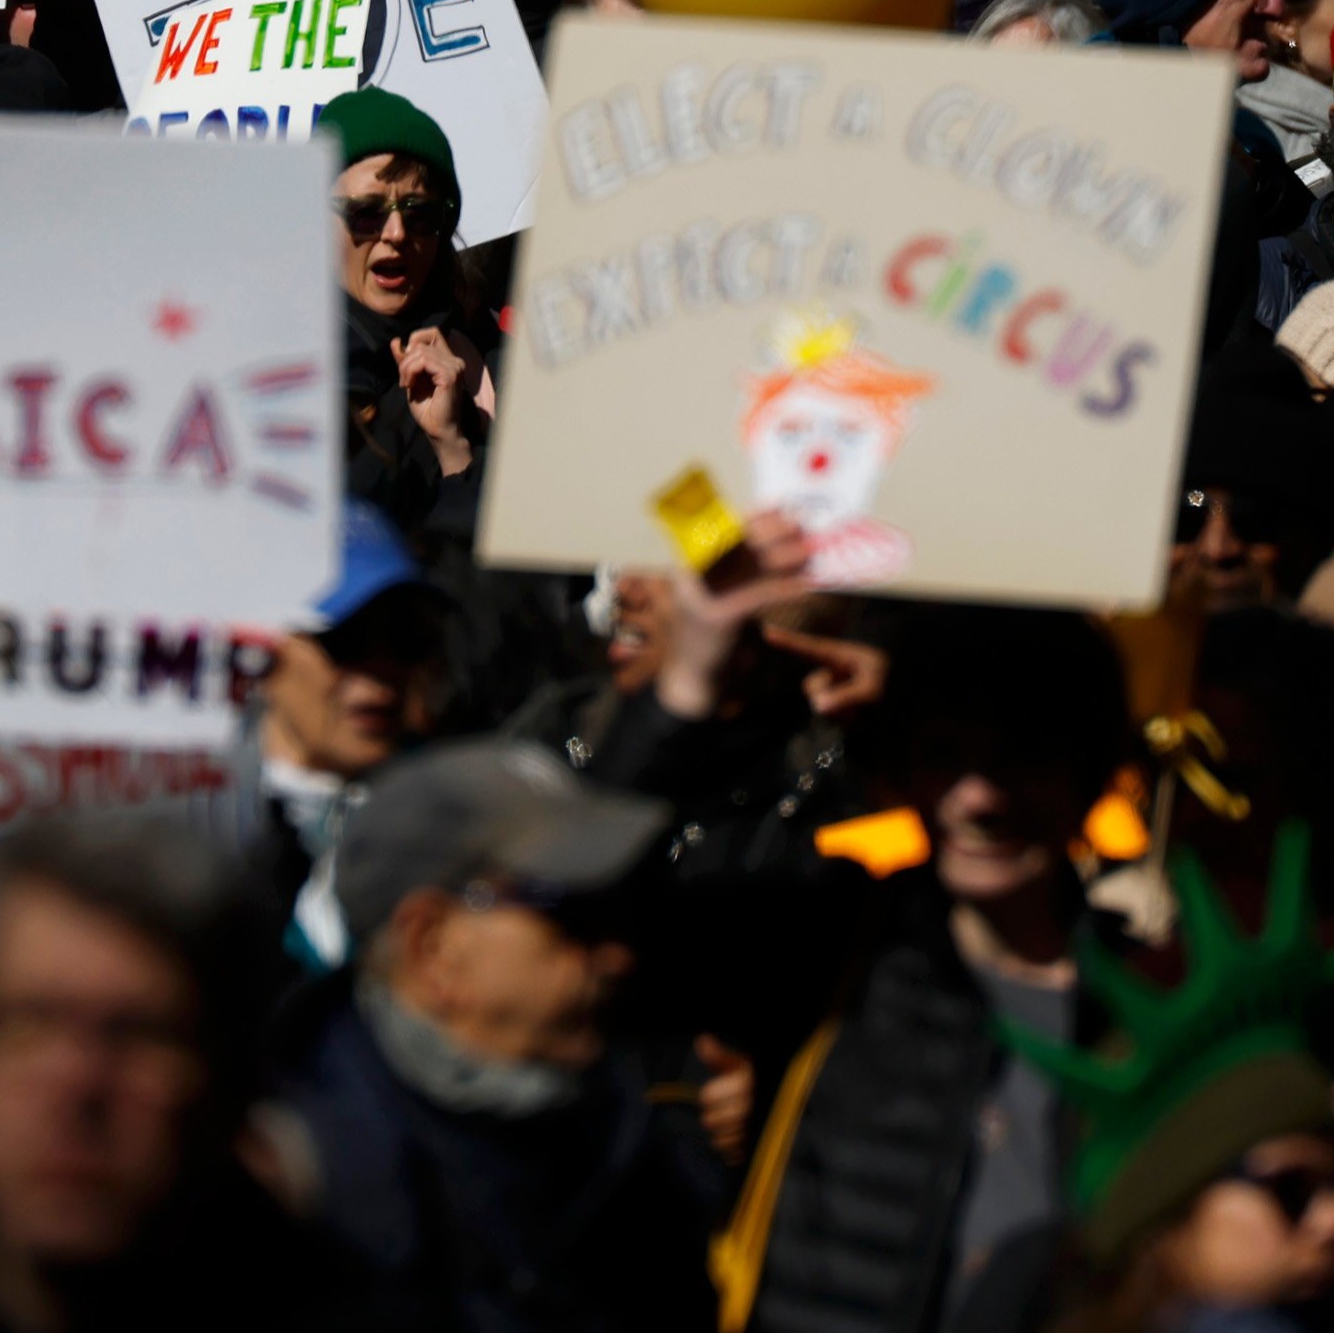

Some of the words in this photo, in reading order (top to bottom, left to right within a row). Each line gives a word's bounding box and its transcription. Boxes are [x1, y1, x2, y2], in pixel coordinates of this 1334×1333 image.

[153, 6, 234, 86] WE
[558, 54, 826, 203] ELECT
[904, 82, 1188, 265] CLOWN
[527, 210, 824, 372] EXPECT
